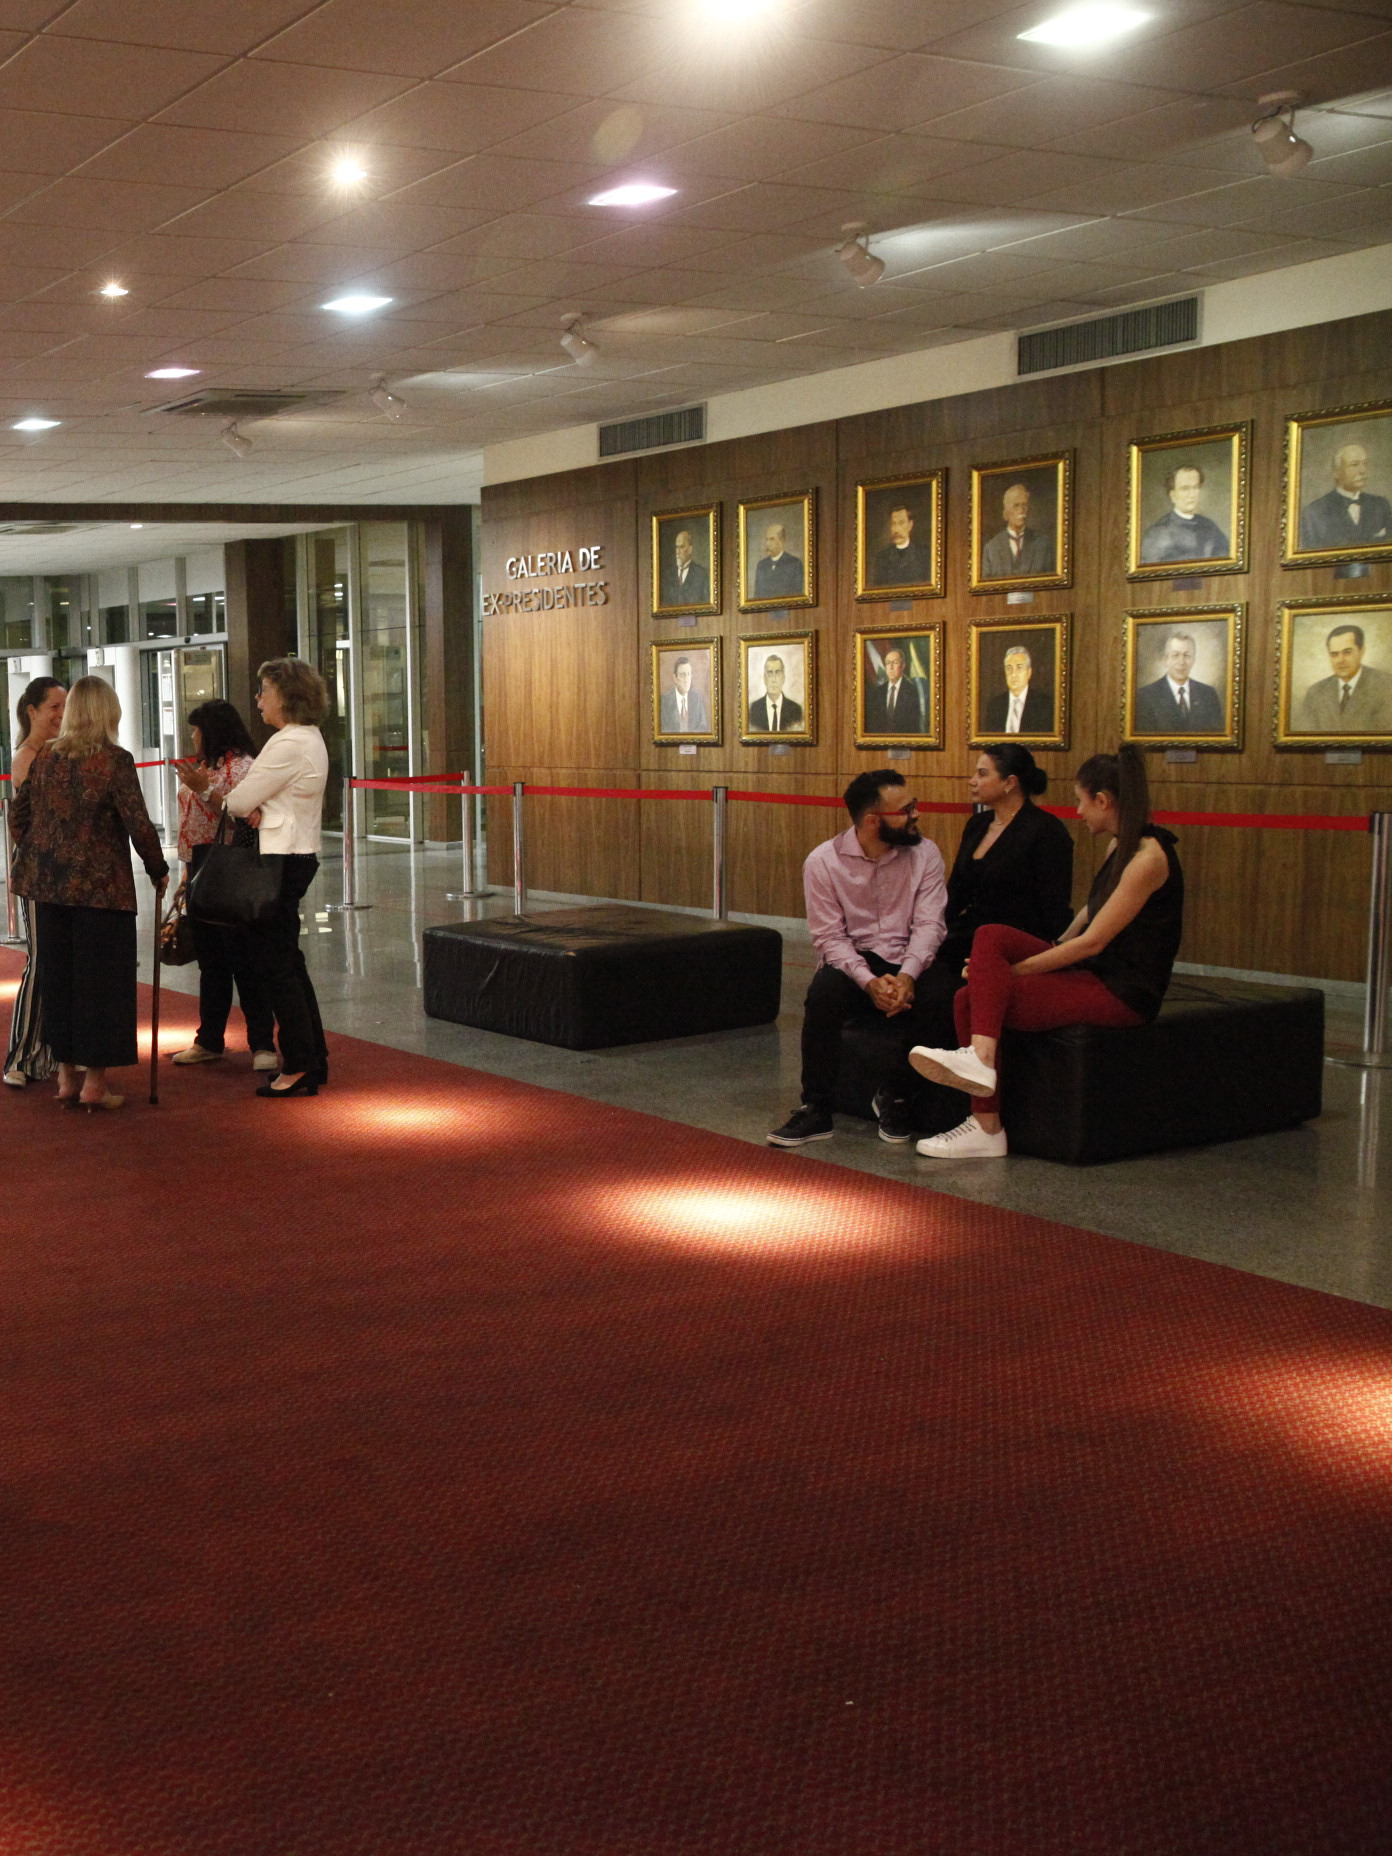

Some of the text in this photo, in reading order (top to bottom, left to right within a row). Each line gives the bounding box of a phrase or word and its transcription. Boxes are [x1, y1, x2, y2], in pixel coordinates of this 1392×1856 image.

[505, 546, 602, 580] GALERIA DE
[482, 581, 608, 616] EX-PRESIDENTES
